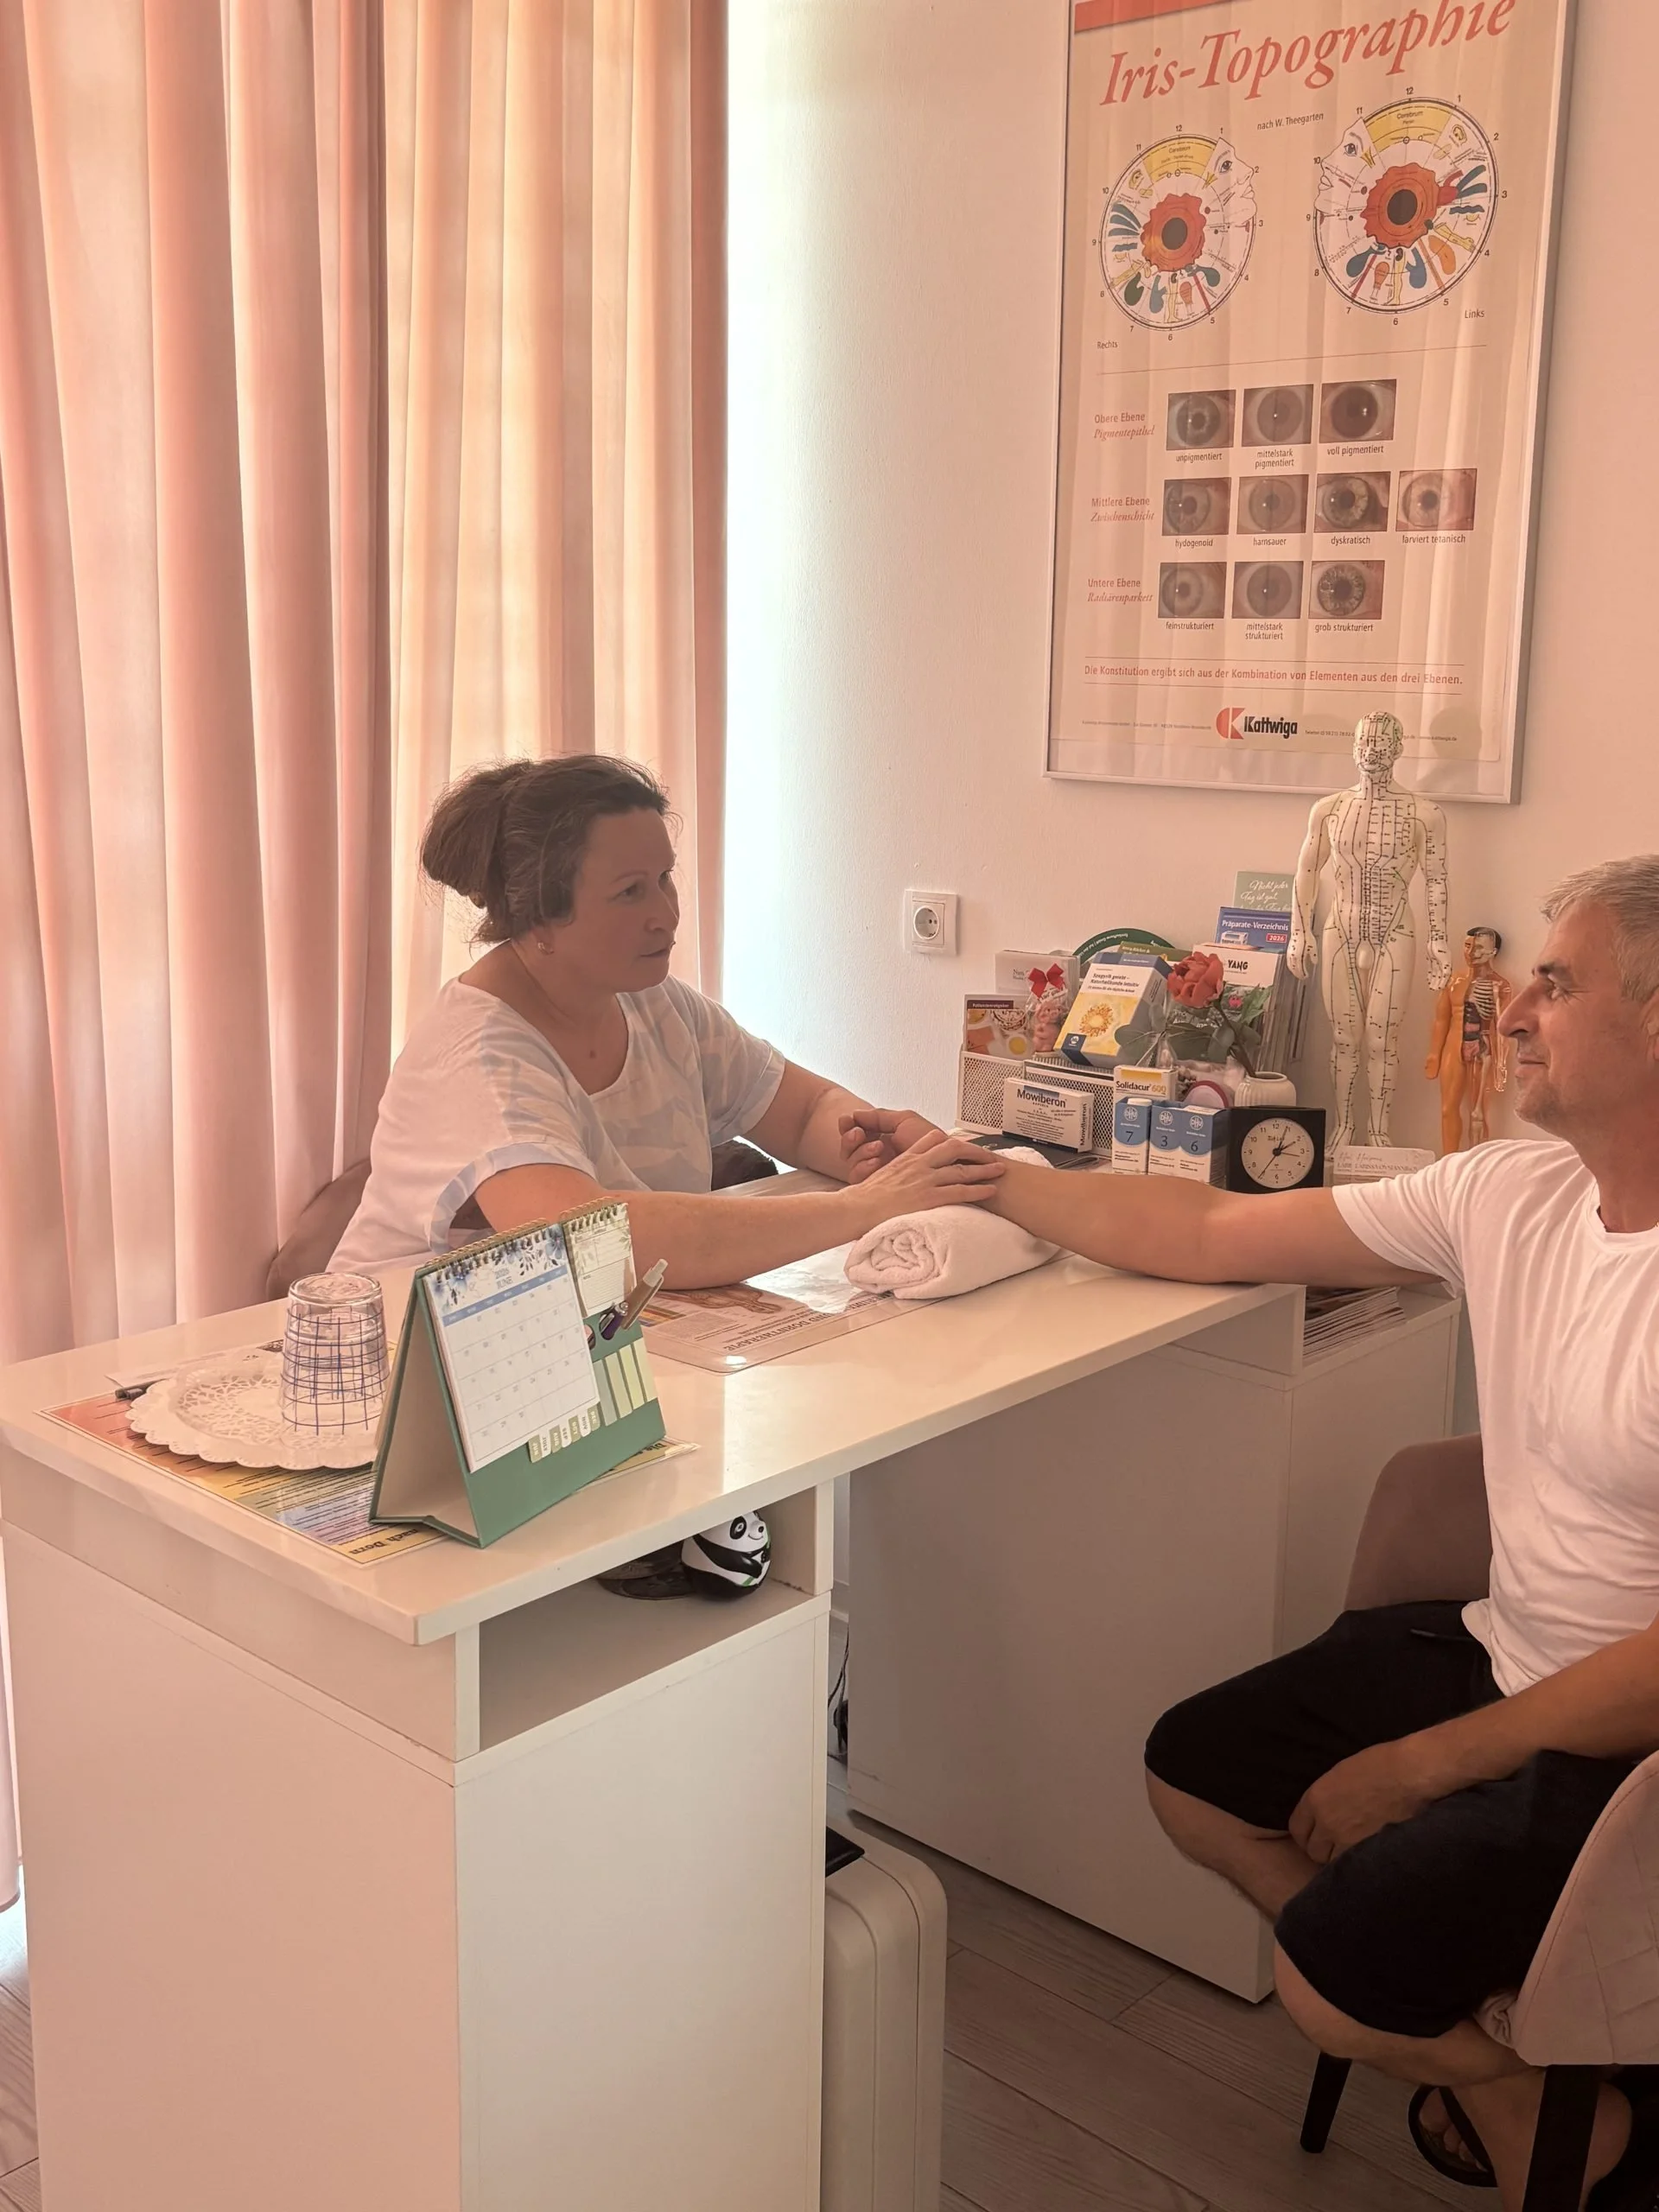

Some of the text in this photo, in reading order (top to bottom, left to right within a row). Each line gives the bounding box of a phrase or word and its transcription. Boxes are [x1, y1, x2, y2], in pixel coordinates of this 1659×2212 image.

[1099, 0, 1516, 105] Iris-Topographie
[1257, 112, 1325, 130] nach W. Theegarten
[1464, 309, 1485, 319] Links
[1393, 317, 1399, 326] 6
[1096, 340, 1118, 350] Rechts
[1094, 413, 1146, 423] Obere Ebene
[1094, 425, 1155, 442] Pigmentepithel
[1257, 448, 1293, 458] mittelstark
[1327, 445, 1384, 457] voll pigmentiert
[1176, 453, 1223, 463] unpigmentiert
[1255, 459, 1294, 469] pigmentiert
[1091, 497, 1150, 507] Mittlere Ebene
[1175, 538, 1213, 549] hydogenoid
[1253, 537, 1287, 546] harnsauer
[1331, 536, 1370, 546] dyskratisch
[1402, 534, 1466, 544] larviert tetanisch
[1088, 578, 1141, 588] Untere Ebene
[1087, 592, 1154, 604] Radiärenparkett
[1166, 621, 1214, 630] feinstrukturiert
[1246, 622, 1283, 631] mittelstark
[1314, 622, 1373, 632] grob strukturiert
[1245, 632, 1283, 640] strukturiert
[1084, 665, 1463, 684] Die Konstitution ergibt sich aus der Kombination von Elementen aus den drei Ebenen.
[1222, 919, 1289, 931] Präparate-Verzeichnis
[1227, 959, 1249, 971] YANG
[1116, 1080, 1151, 1091] Solidacur
[1017, 1088, 1067, 1108] Mowiberon
[1125, 1130, 1134, 1142] 7
[1160, 1135, 1168, 1147] 3
[1191, 1141, 1198, 1153] 6
[349, 1529, 418, 1554] nach Dorn
